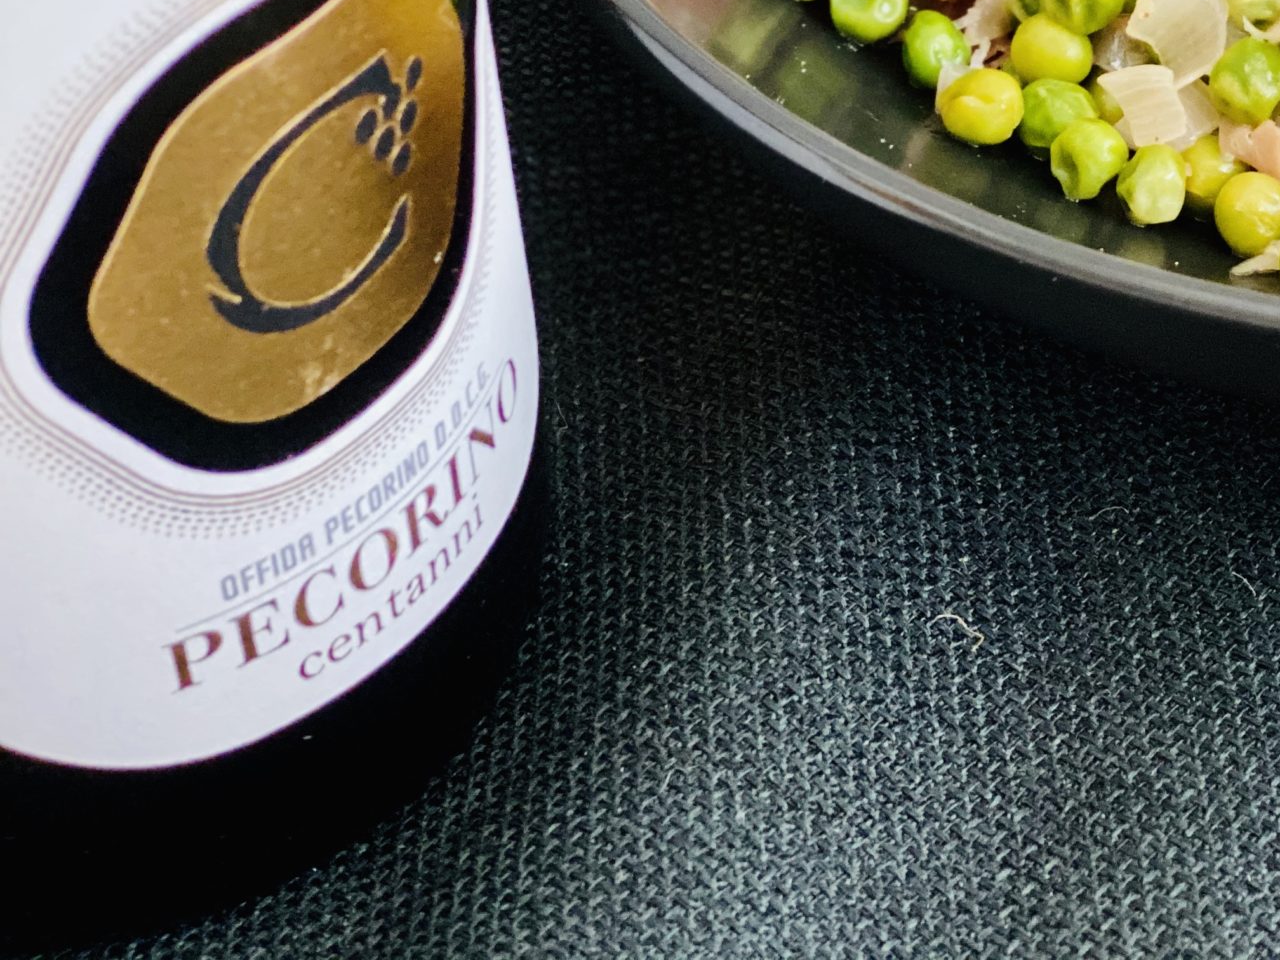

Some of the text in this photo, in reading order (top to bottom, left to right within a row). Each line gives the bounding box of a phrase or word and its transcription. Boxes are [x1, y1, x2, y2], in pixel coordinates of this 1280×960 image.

[162, 357, 518, 694] PECORINO
[220, 534, 317, 603] OFFIDA
[323, 443, 430, 546] PECORINO
[298, 492, 484, 681] centanni
